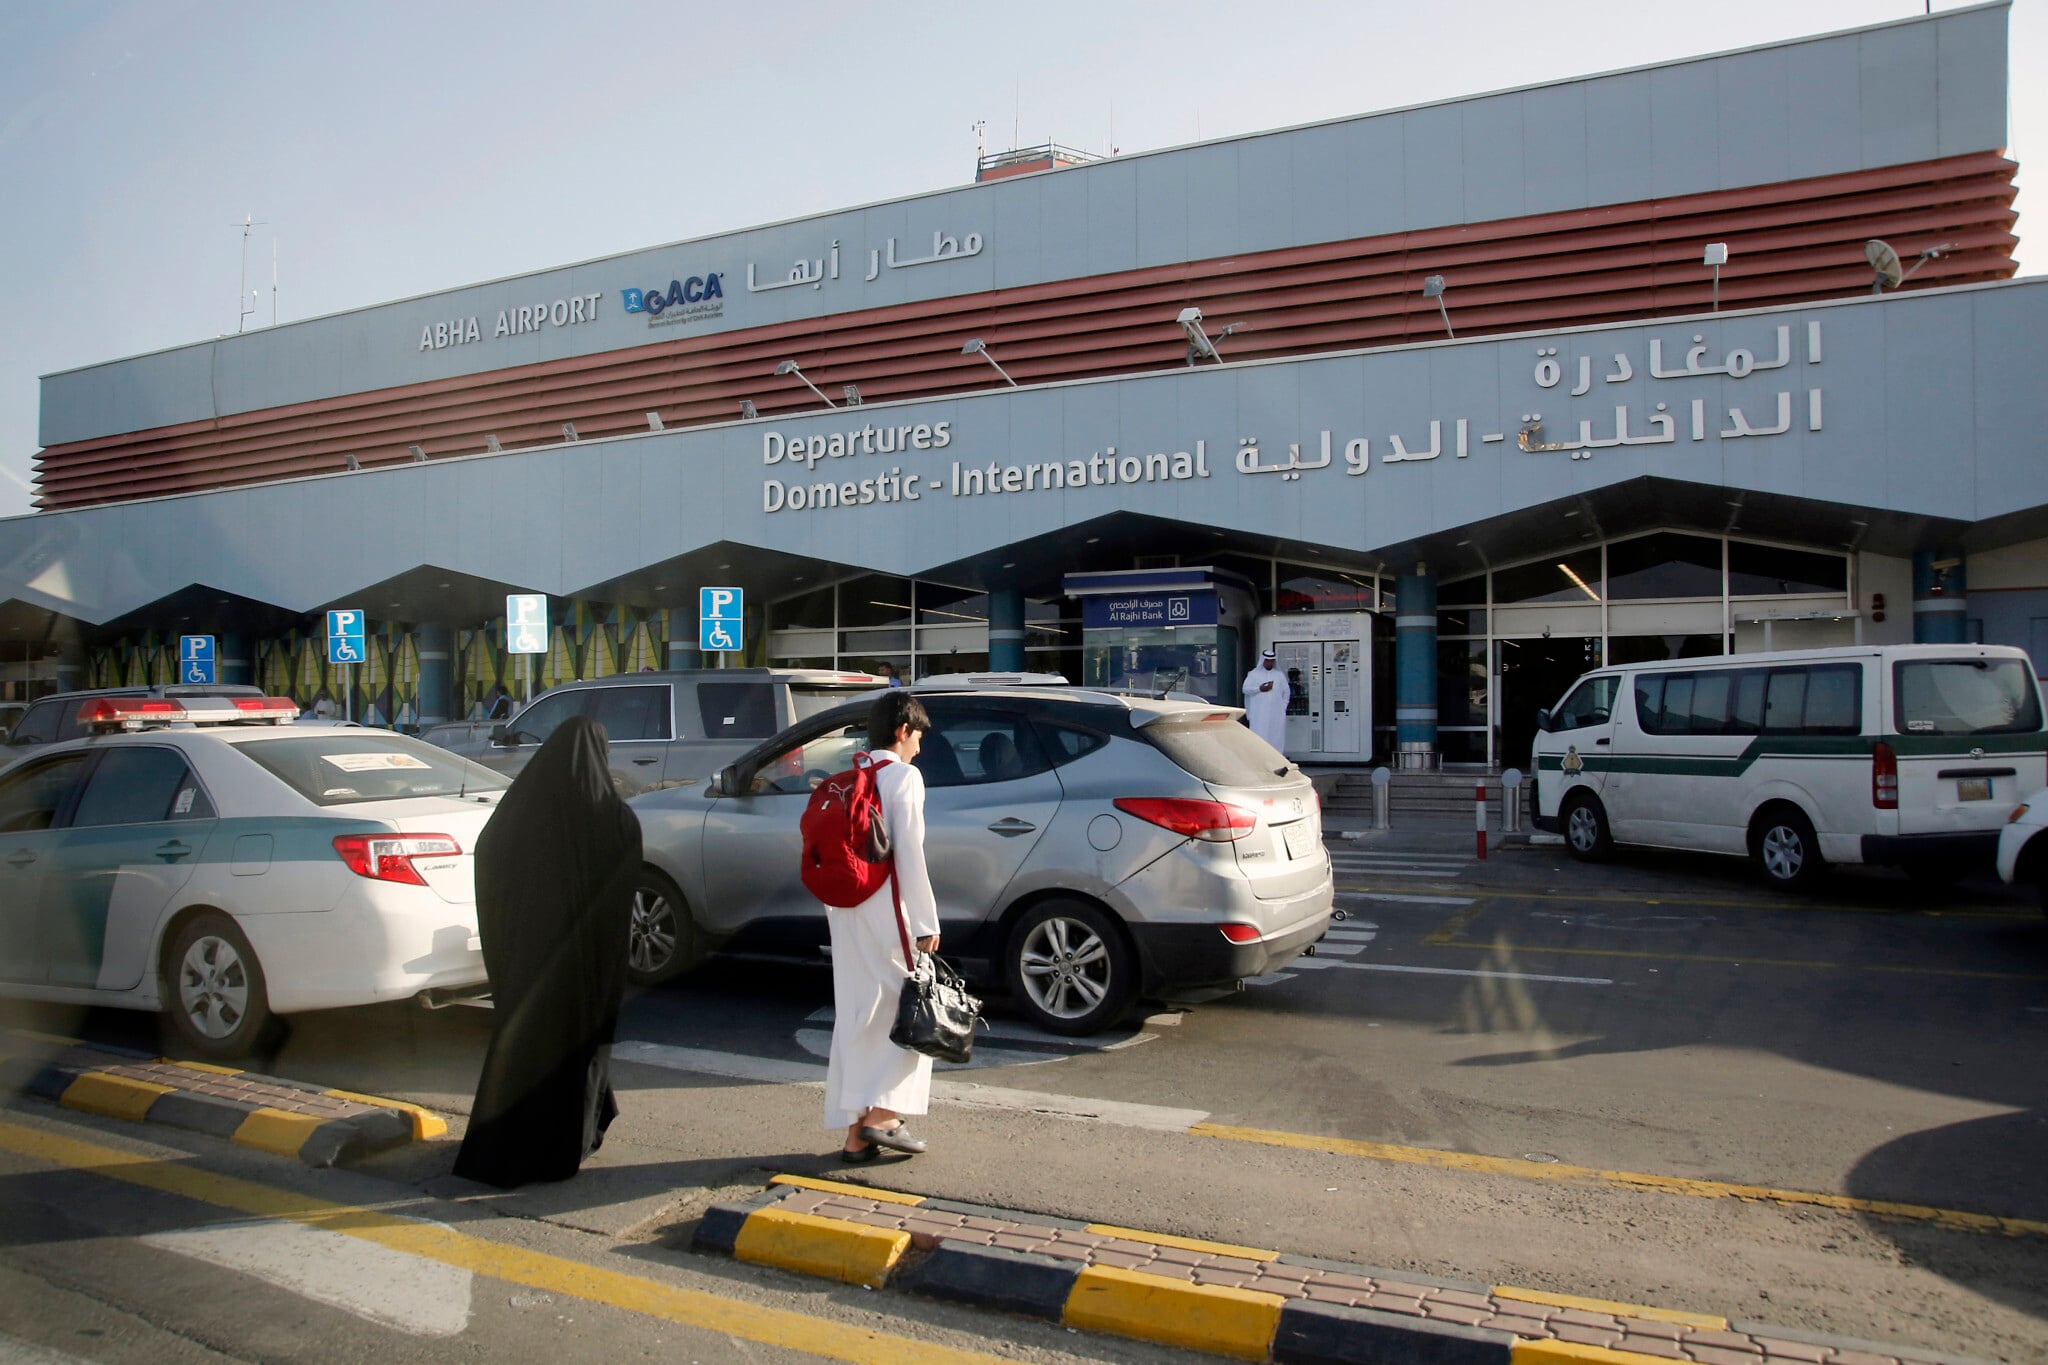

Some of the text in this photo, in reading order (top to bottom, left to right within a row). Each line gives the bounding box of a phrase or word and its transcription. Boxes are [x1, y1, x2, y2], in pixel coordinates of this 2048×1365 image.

[747, 231, 984, 292] مطار أبها
[643, 272, 723, 315] GACA
[419, 292, 602, 352] ABHA AIRPORT
[1533, 320, 1822, 396] المغادرة
[763, 420, 951, 470] Departures
[1235, 417, 1468, 481] الدولية
[763, 466, 920, 513] Domestic
[952, 439, 1210, 496] International
[335, 612, 355, 635] P
[515, 597, 538, 624] P
[709, 590, 733, 617] P
[1109, 599, 1163, 611] مصرف الراجحي
[1109, 610, 1163, 622] Al Rajhi Bank
[188, 637, 207, 659] P
